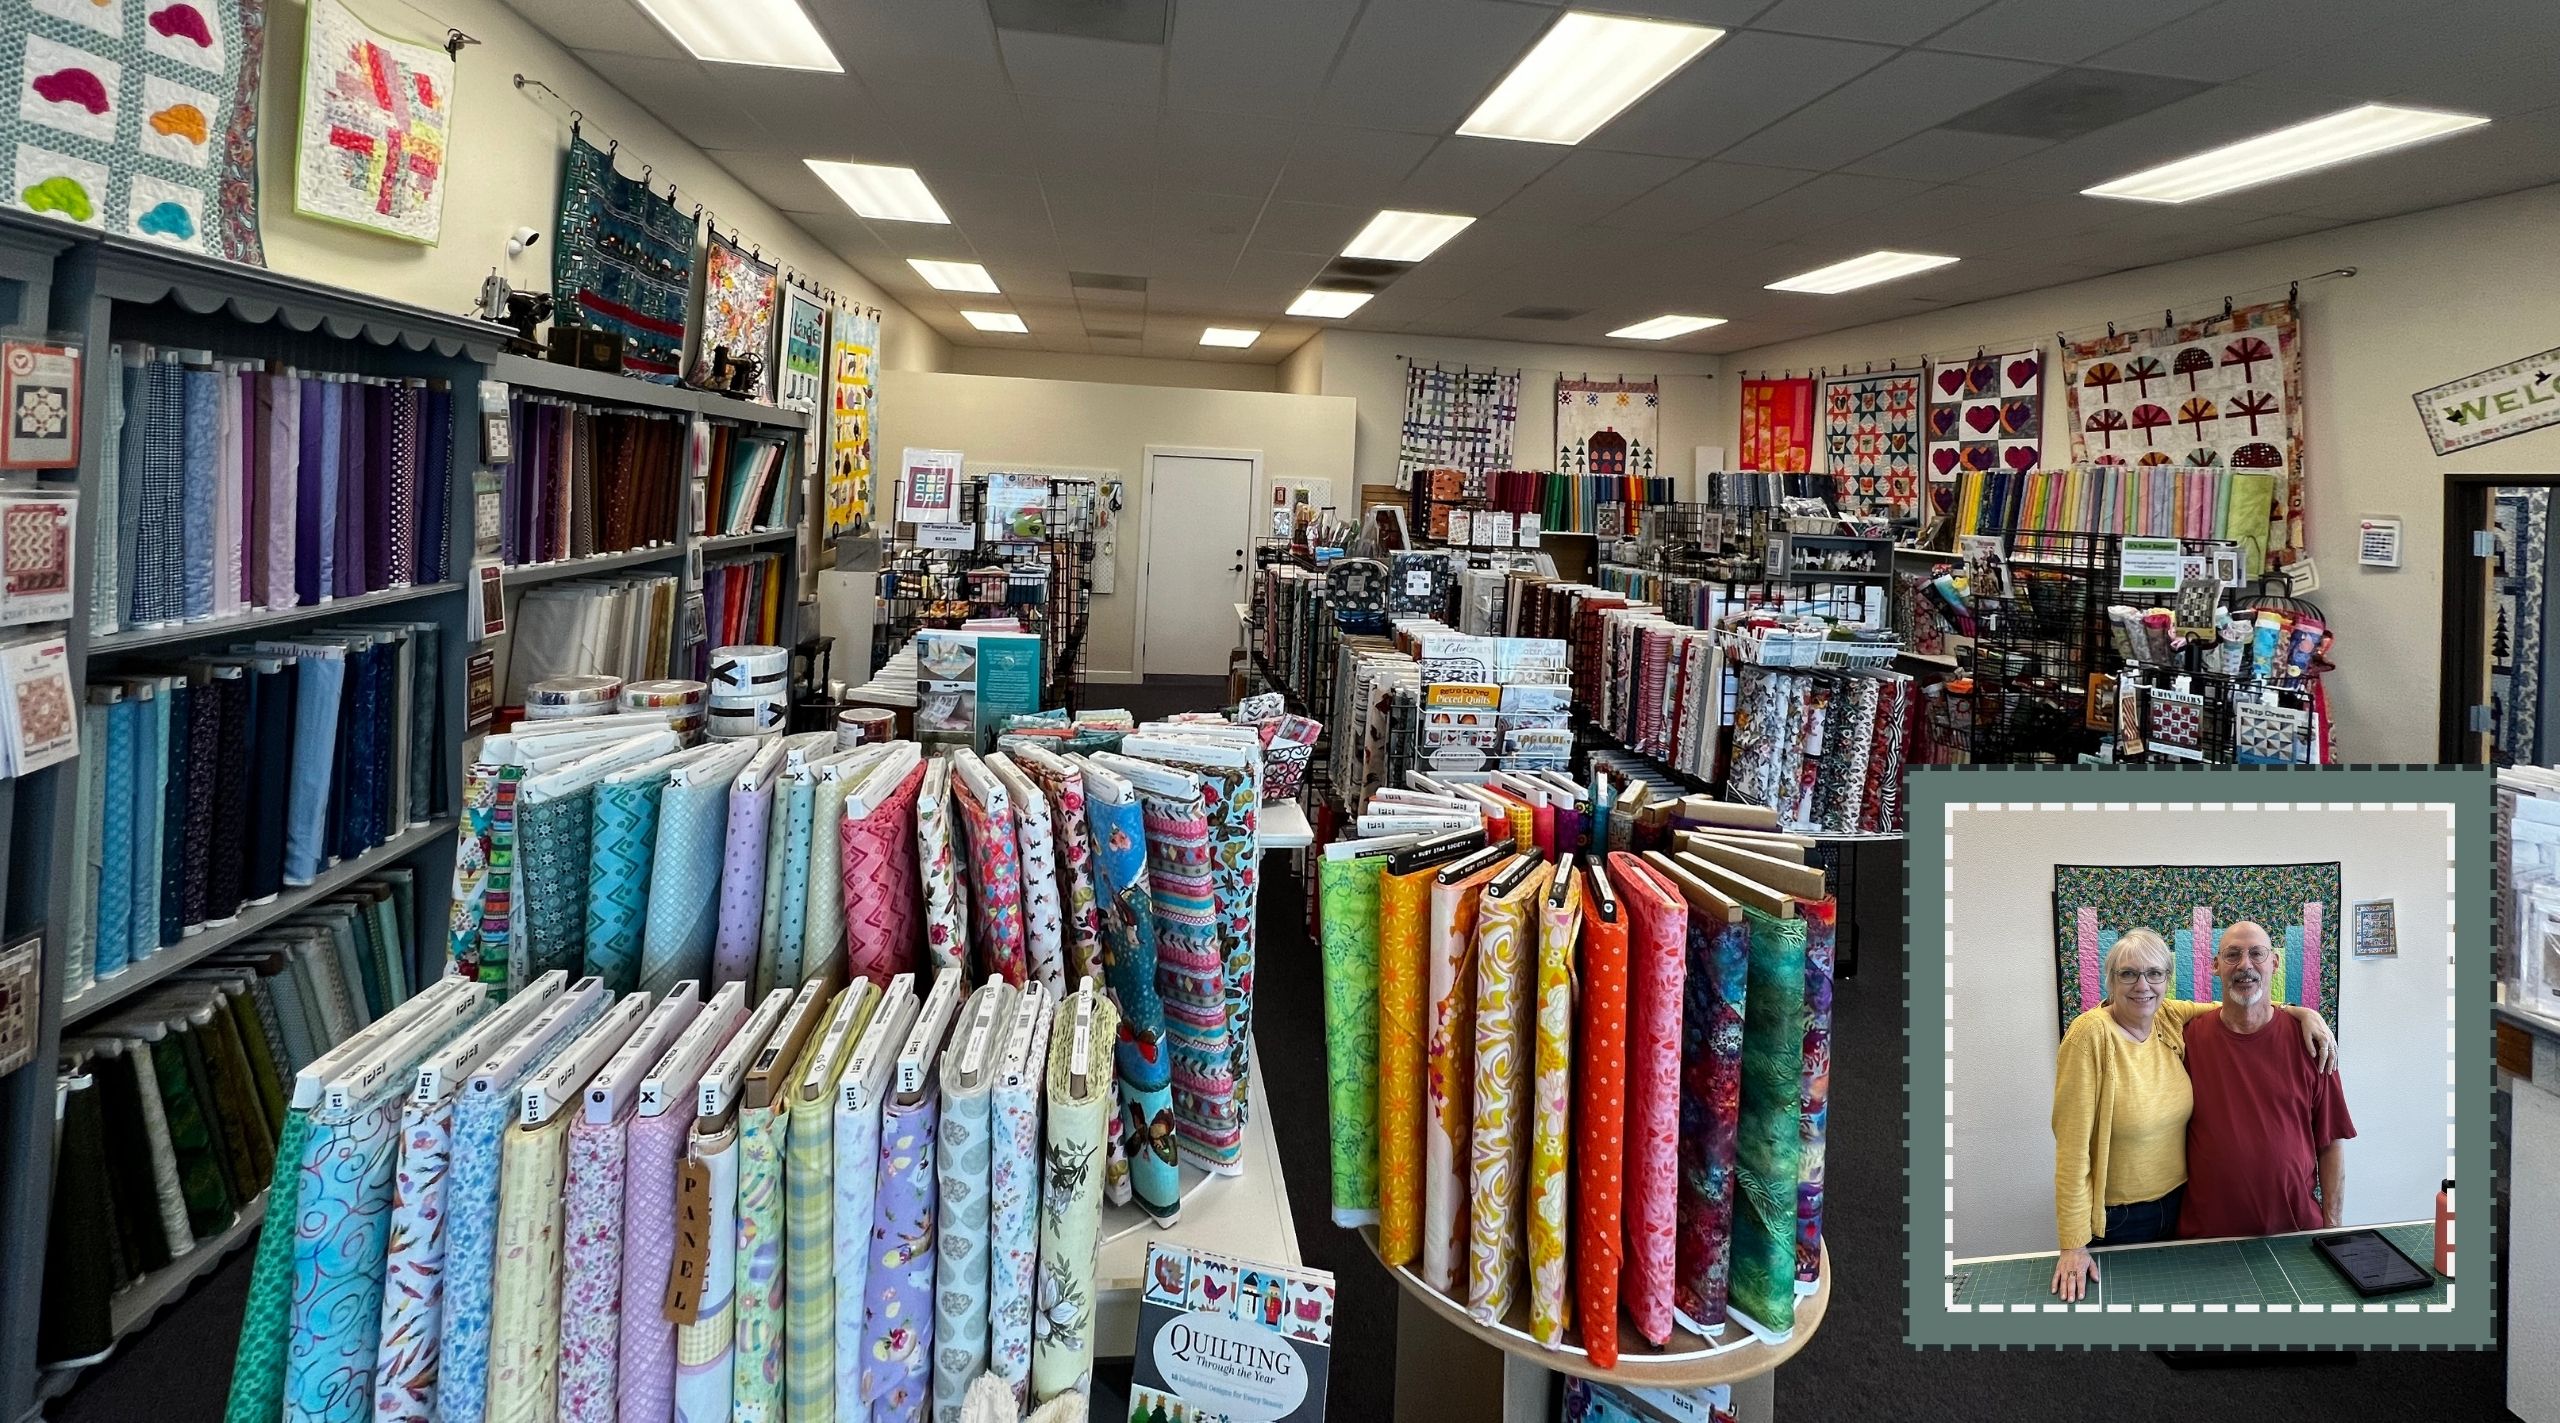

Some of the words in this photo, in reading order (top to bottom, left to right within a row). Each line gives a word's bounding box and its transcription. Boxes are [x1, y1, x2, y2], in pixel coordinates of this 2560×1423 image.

[1436, 694, 1467, 704] Pieced
[1466, 695, 1491, 706] Quilts
[2241, 706, 2264, 717] Whip
[2264, 710, 2296, 720] Cream
[1447, 841, 1467, 850] SOCIETY
[674, 1176, 698, 1311] PANEL
[1170, 1323, 1292, 1376] QUILTING
[1196, 1355, 1236, 1378] Through
[1237, 1366, 1252, 1379] the
[1254, 1373, 1276, 1386] Year
[1208, 1384, 1233, 1397] Designs
